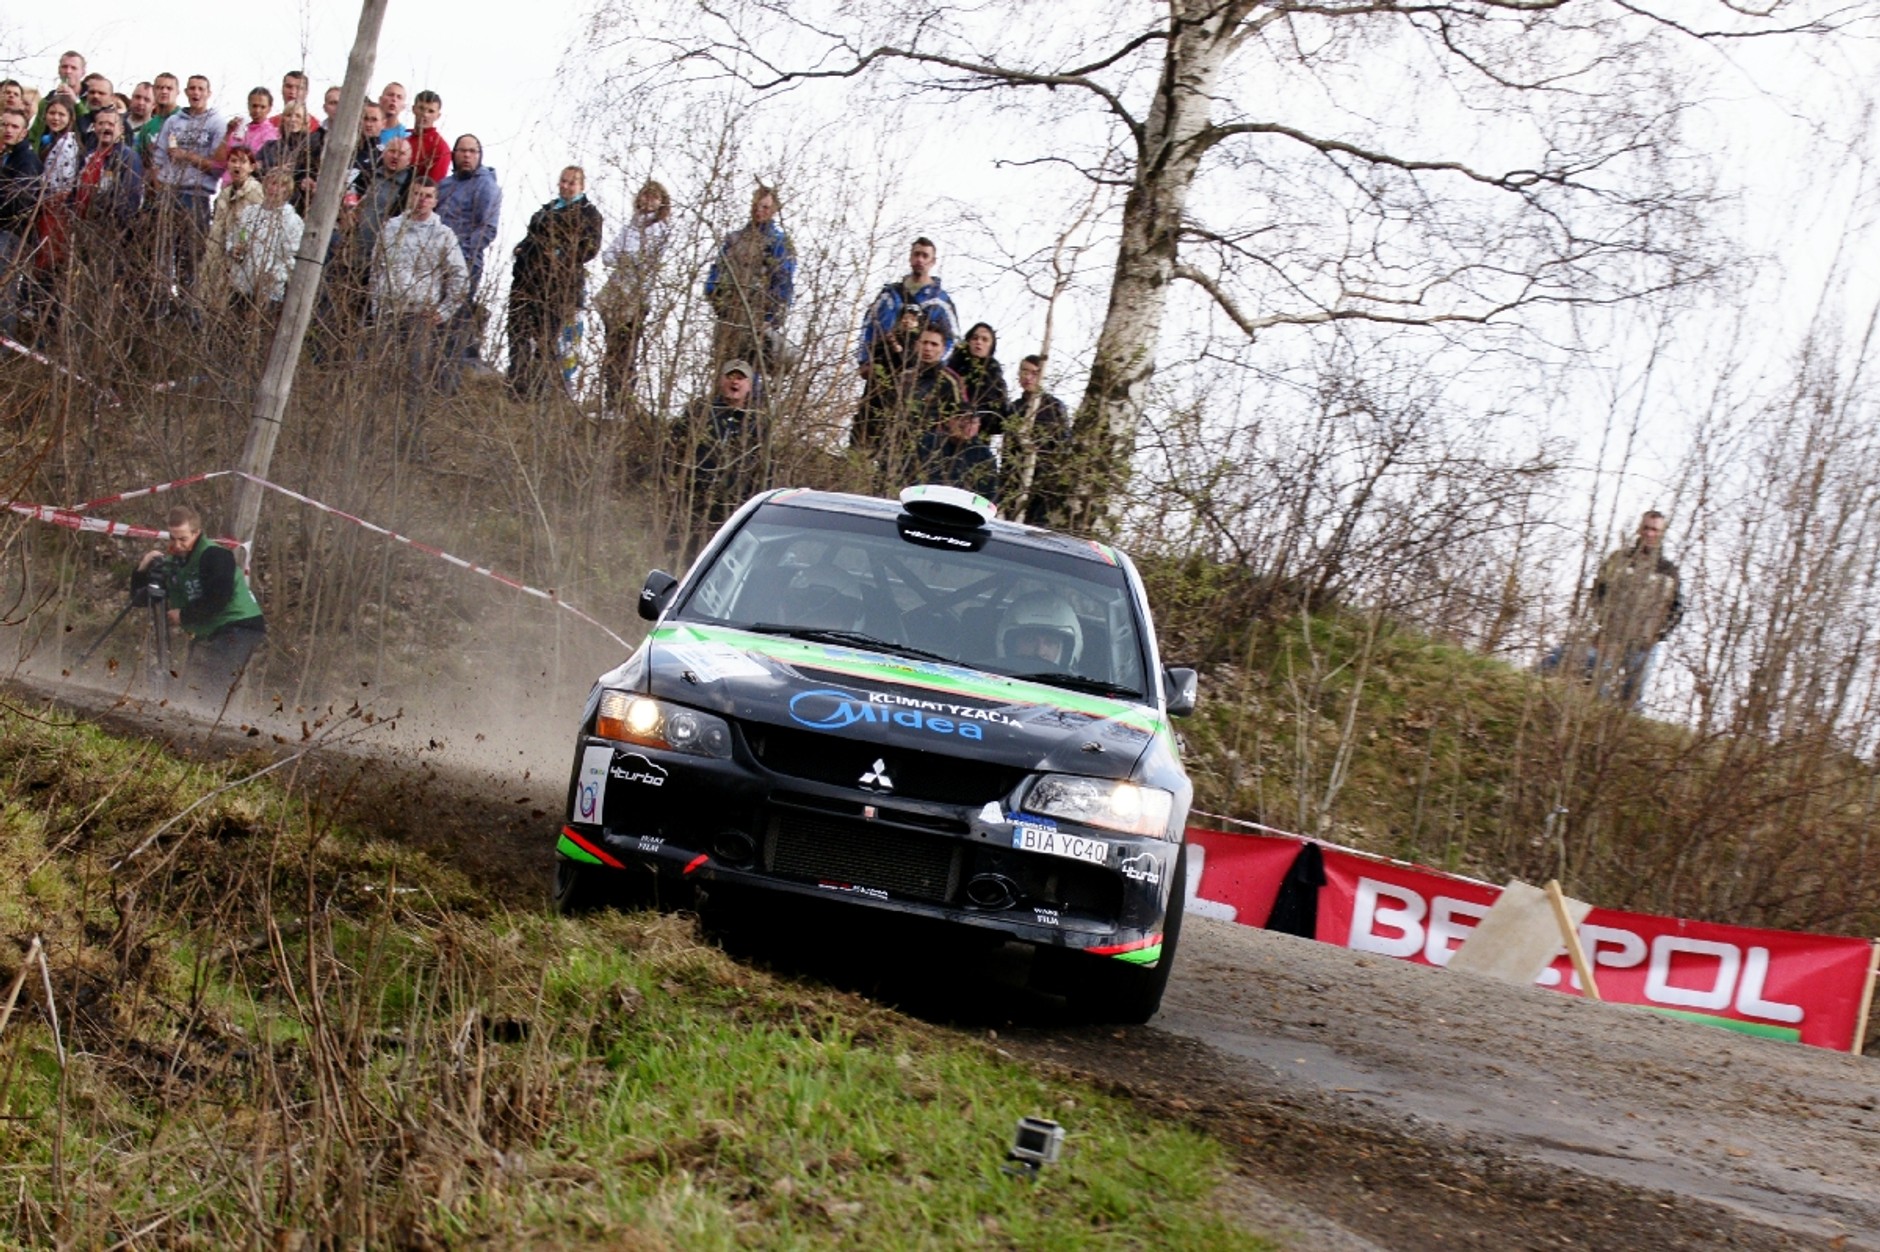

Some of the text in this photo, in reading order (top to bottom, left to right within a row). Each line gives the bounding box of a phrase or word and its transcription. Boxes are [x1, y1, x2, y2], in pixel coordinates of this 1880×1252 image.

[800, 695, 983, 741] Midea
[868, 692, 1024, 730] KLIMATYZACJA
[610, 765, 665, 787] 4turbo
[1025, 830, 1104, 862] BIA YC40
[1122, 864, 1160, 884] 4turbo
[1347, 875, 1804, 1023] BEPOL
